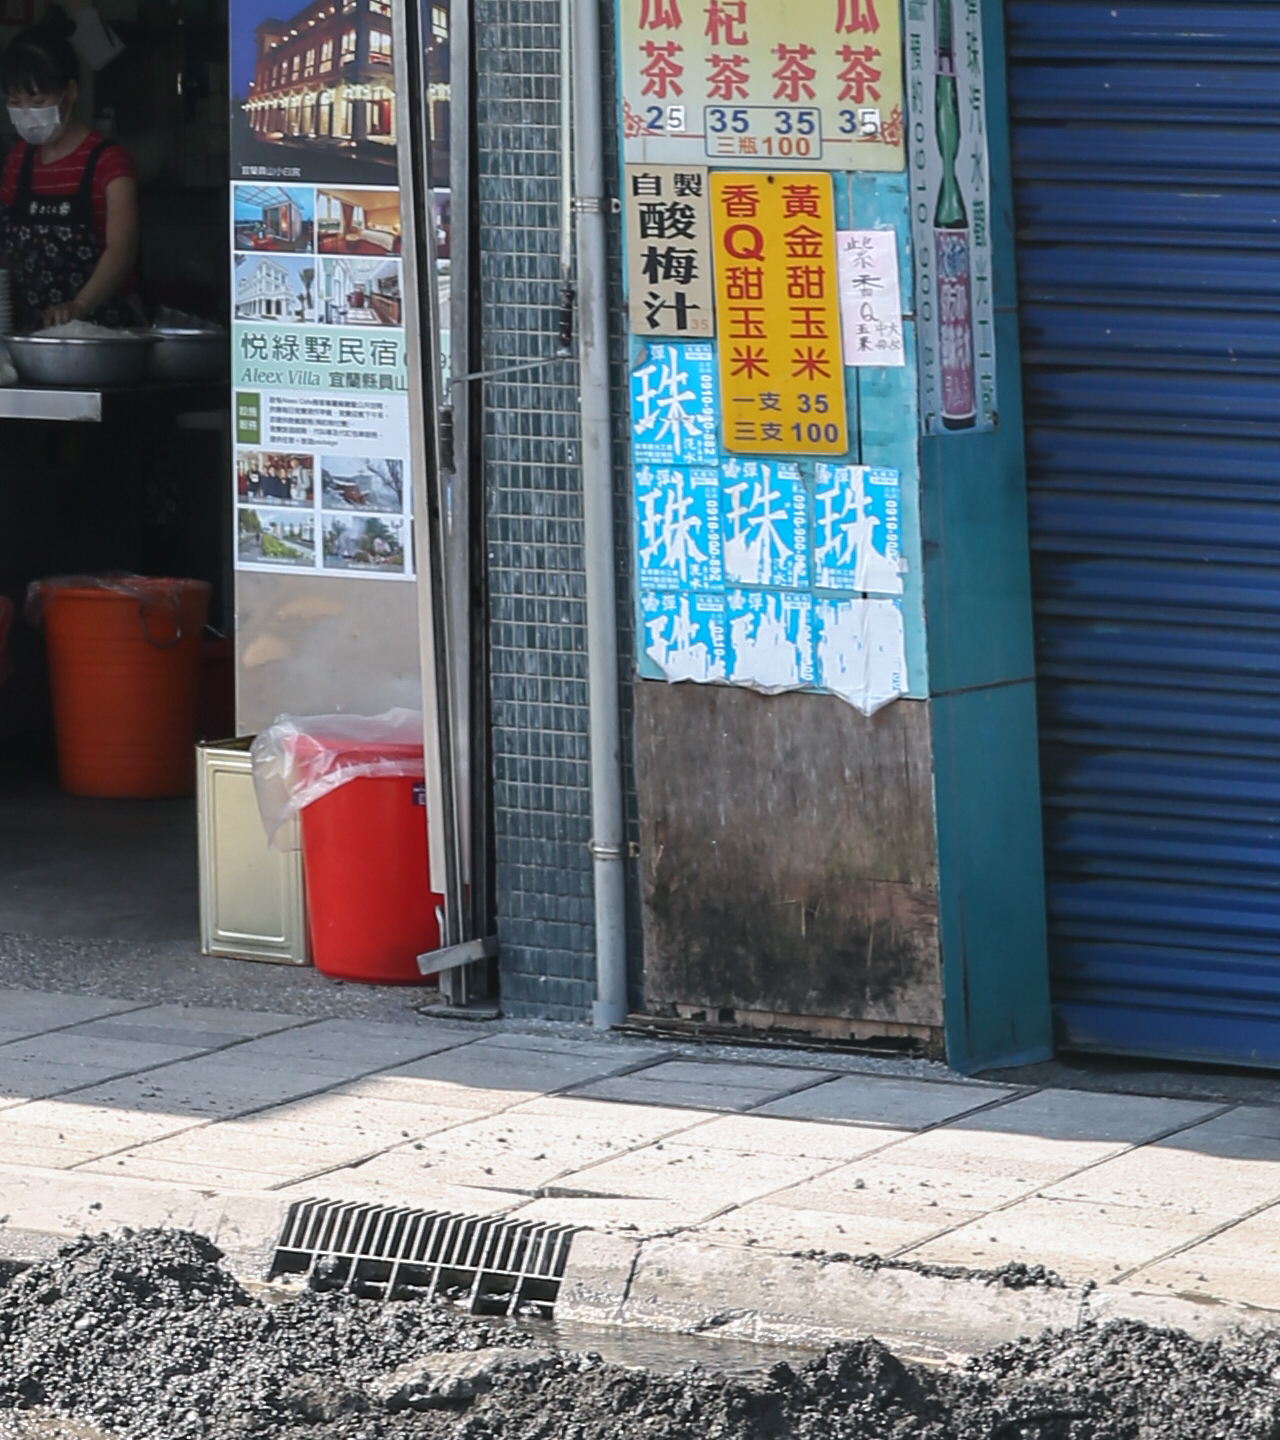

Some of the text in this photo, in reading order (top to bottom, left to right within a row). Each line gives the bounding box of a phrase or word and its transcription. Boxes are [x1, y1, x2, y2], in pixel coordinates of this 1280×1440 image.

[645, 106, 685, 131] 25
[709, 109, 816, 135] 35 35
[838, 110, 880, 137] 35
[762, 136, 811, 157] 100
[632, 173, 703, 198] 自製
[638, 201, 701, 331] 酸梅汁
[721, 183, 770, 380] 香Q甜玉米
[781, 183, 831, 381] 黃金甜玉米
[691, 318, 710, 331] 35
[240, 367, 284, 384] Aleex
[288, 369, 321, 386] Villa
[731, 392, 829, 414] 一支 35
[734, 421, 839, 444] 三支 100
